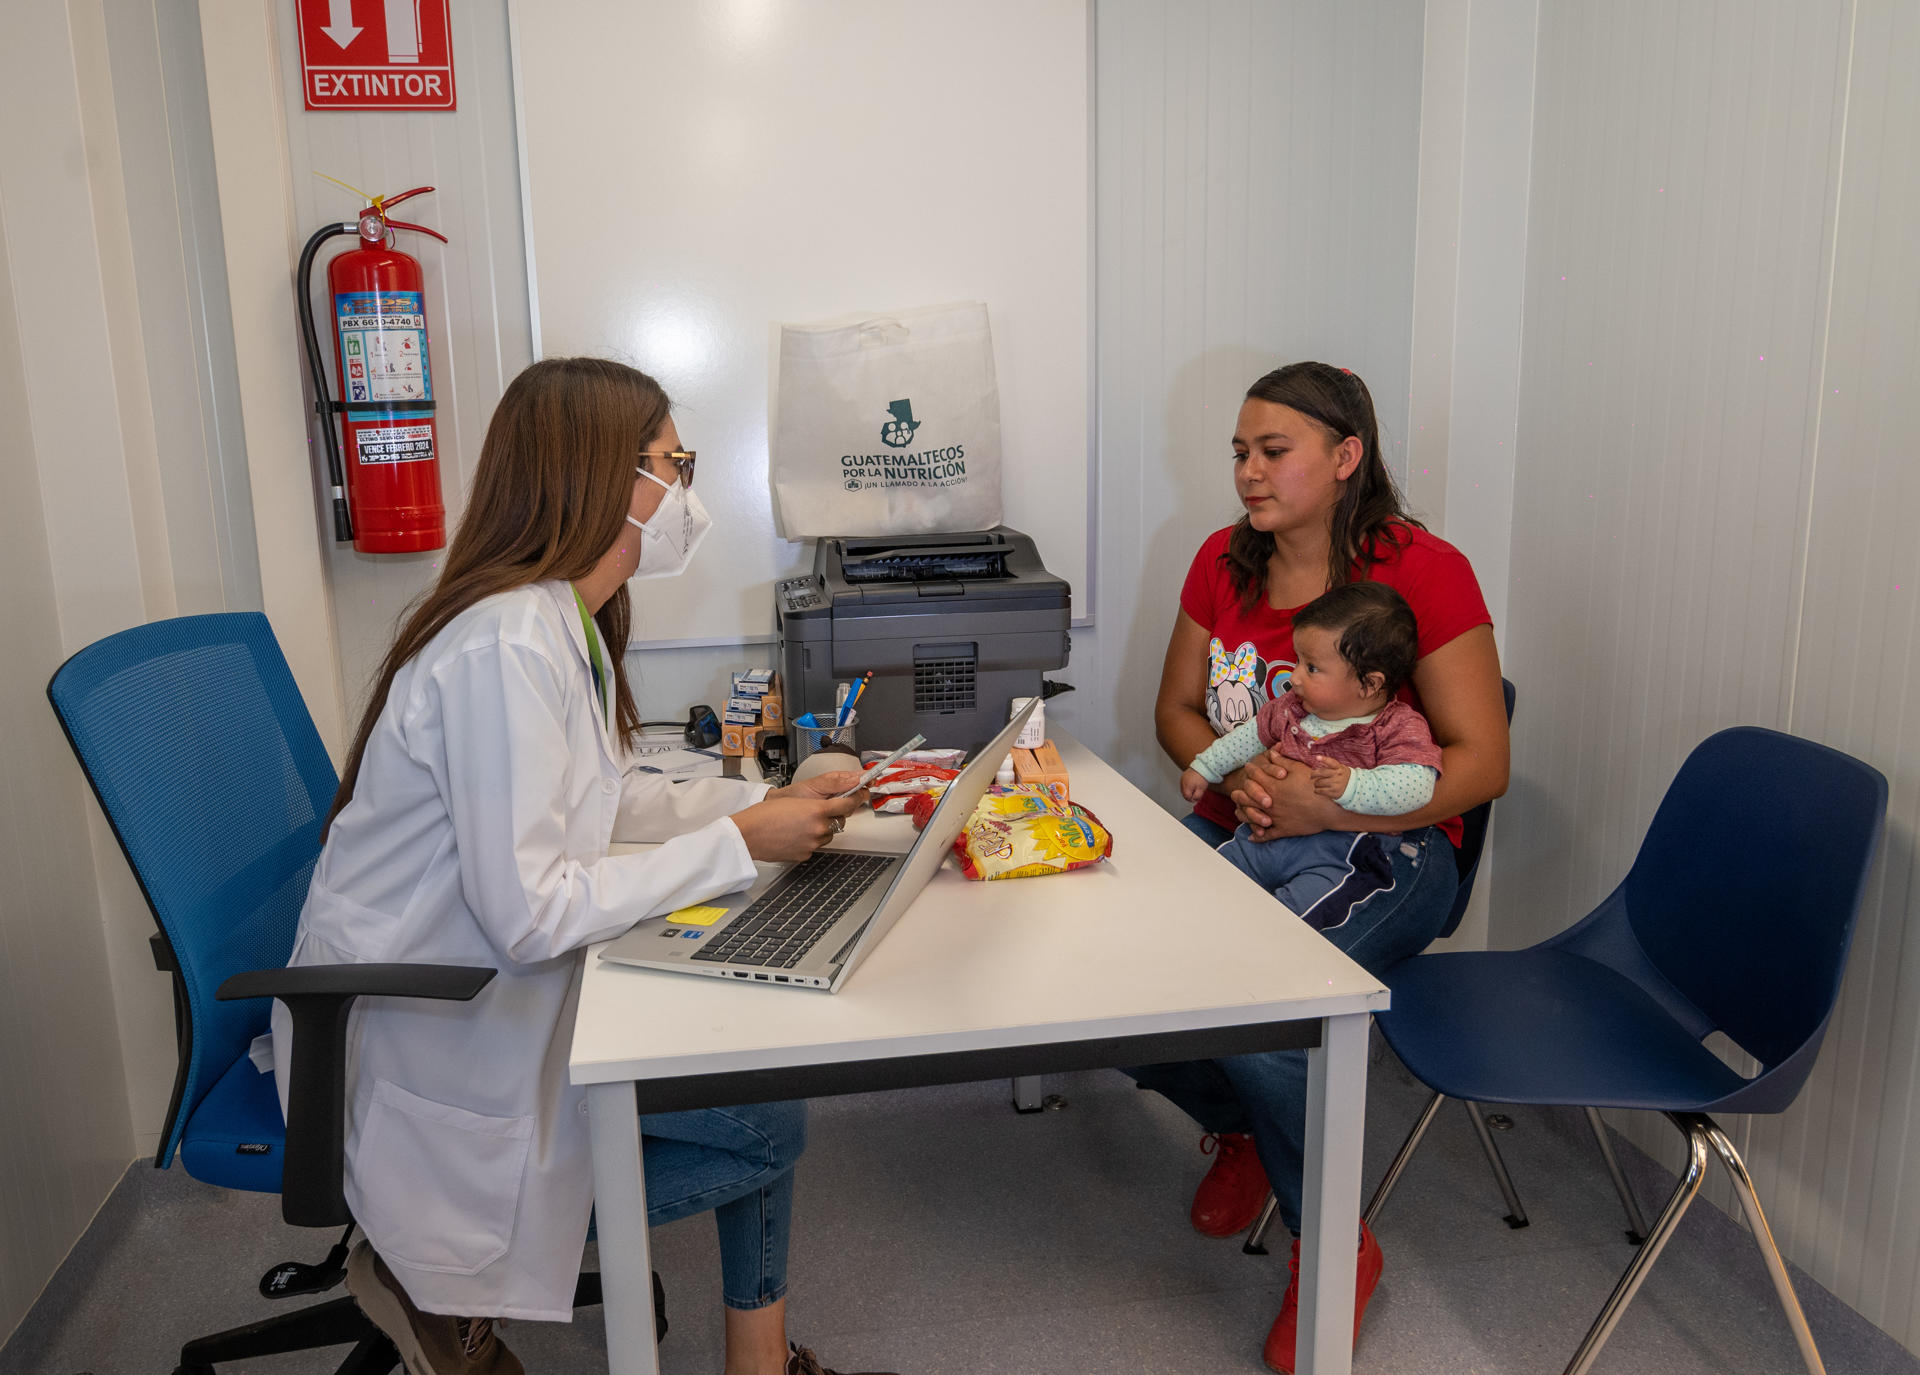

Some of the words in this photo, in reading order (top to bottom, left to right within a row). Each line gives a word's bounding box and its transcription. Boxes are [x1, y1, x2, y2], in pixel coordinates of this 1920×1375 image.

[314, 74, 443, 97] EXTINTOR
[342, 319, 360, 328] PBX
[364, 444, 385, 454] VENCE
[386, 442, 415, 453] FEBRERO
[841, 444, 965, 467] GUATEMALTECOS
[843, 468, 866, 478] POR
[868, 469, 882, 477] LA
[884, 460, 966, 480] NUTRICIÓN
[880, 480, 918, 488] LLAMADO
